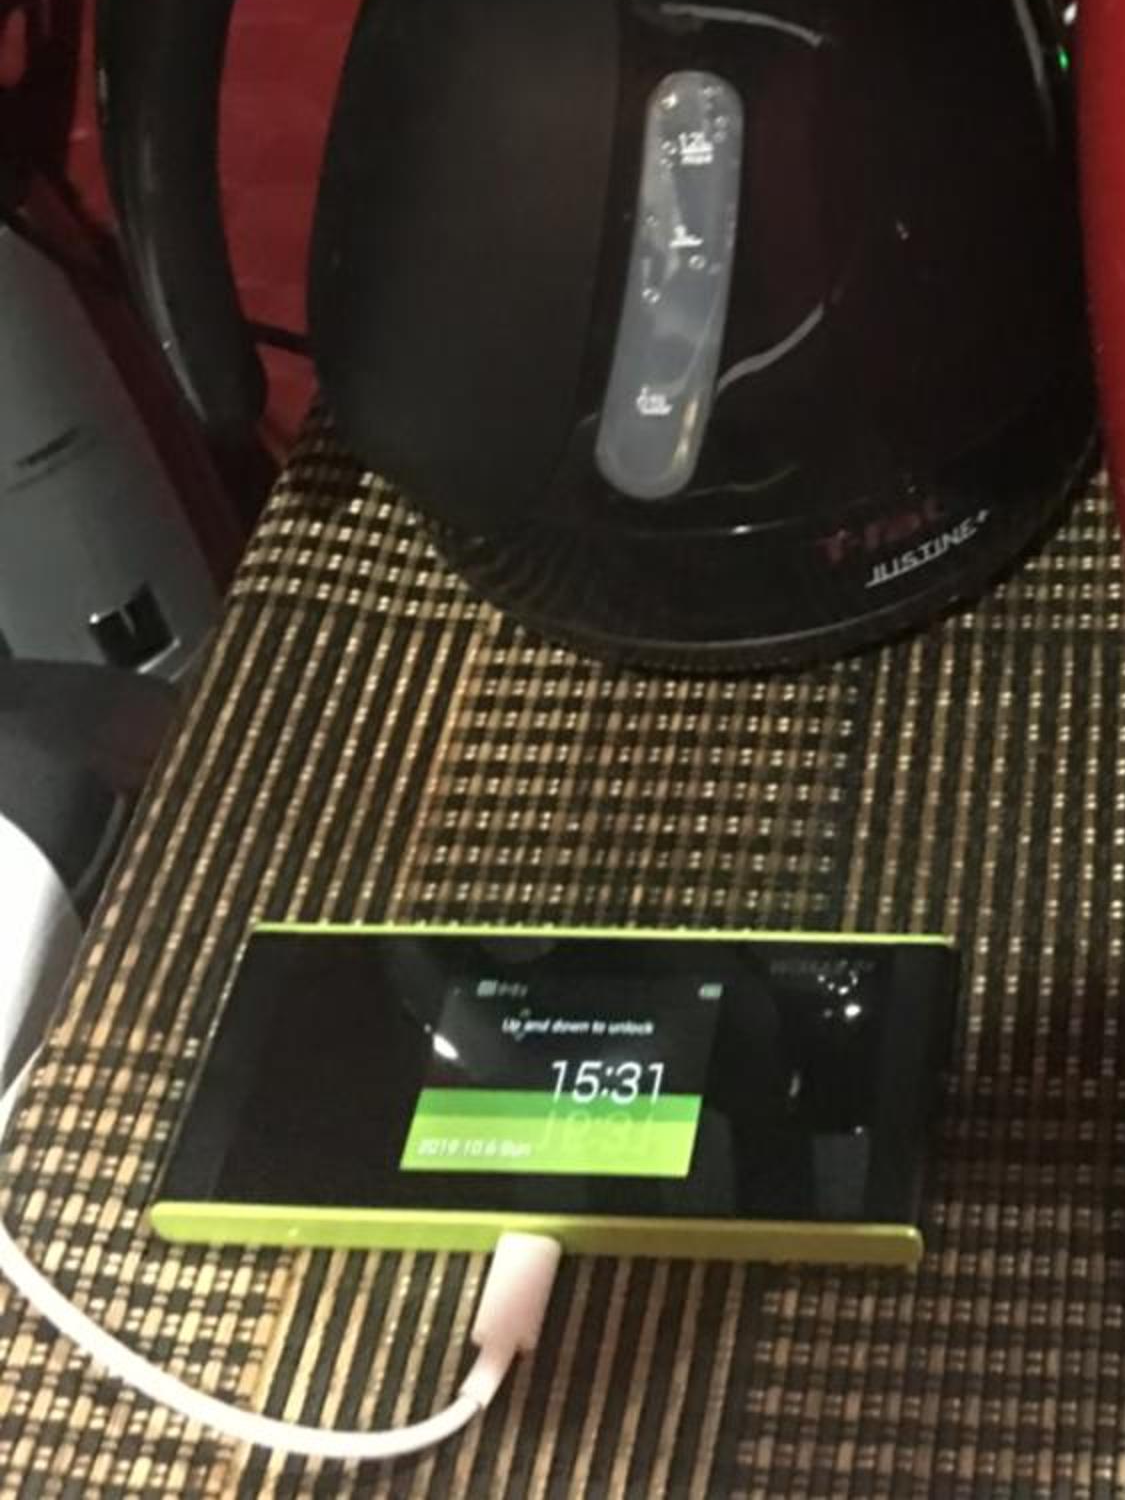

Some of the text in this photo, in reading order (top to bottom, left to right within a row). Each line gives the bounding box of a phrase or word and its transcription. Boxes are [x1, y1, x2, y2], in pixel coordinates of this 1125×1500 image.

[523, 1018, 550, 1033] and
[552, 1018, 590, 1034] down
[592, 1020, 606, 1034] to
[608, 1021, 655, 1036] unlock
[552, 1060, 664, 1105] 15:31
